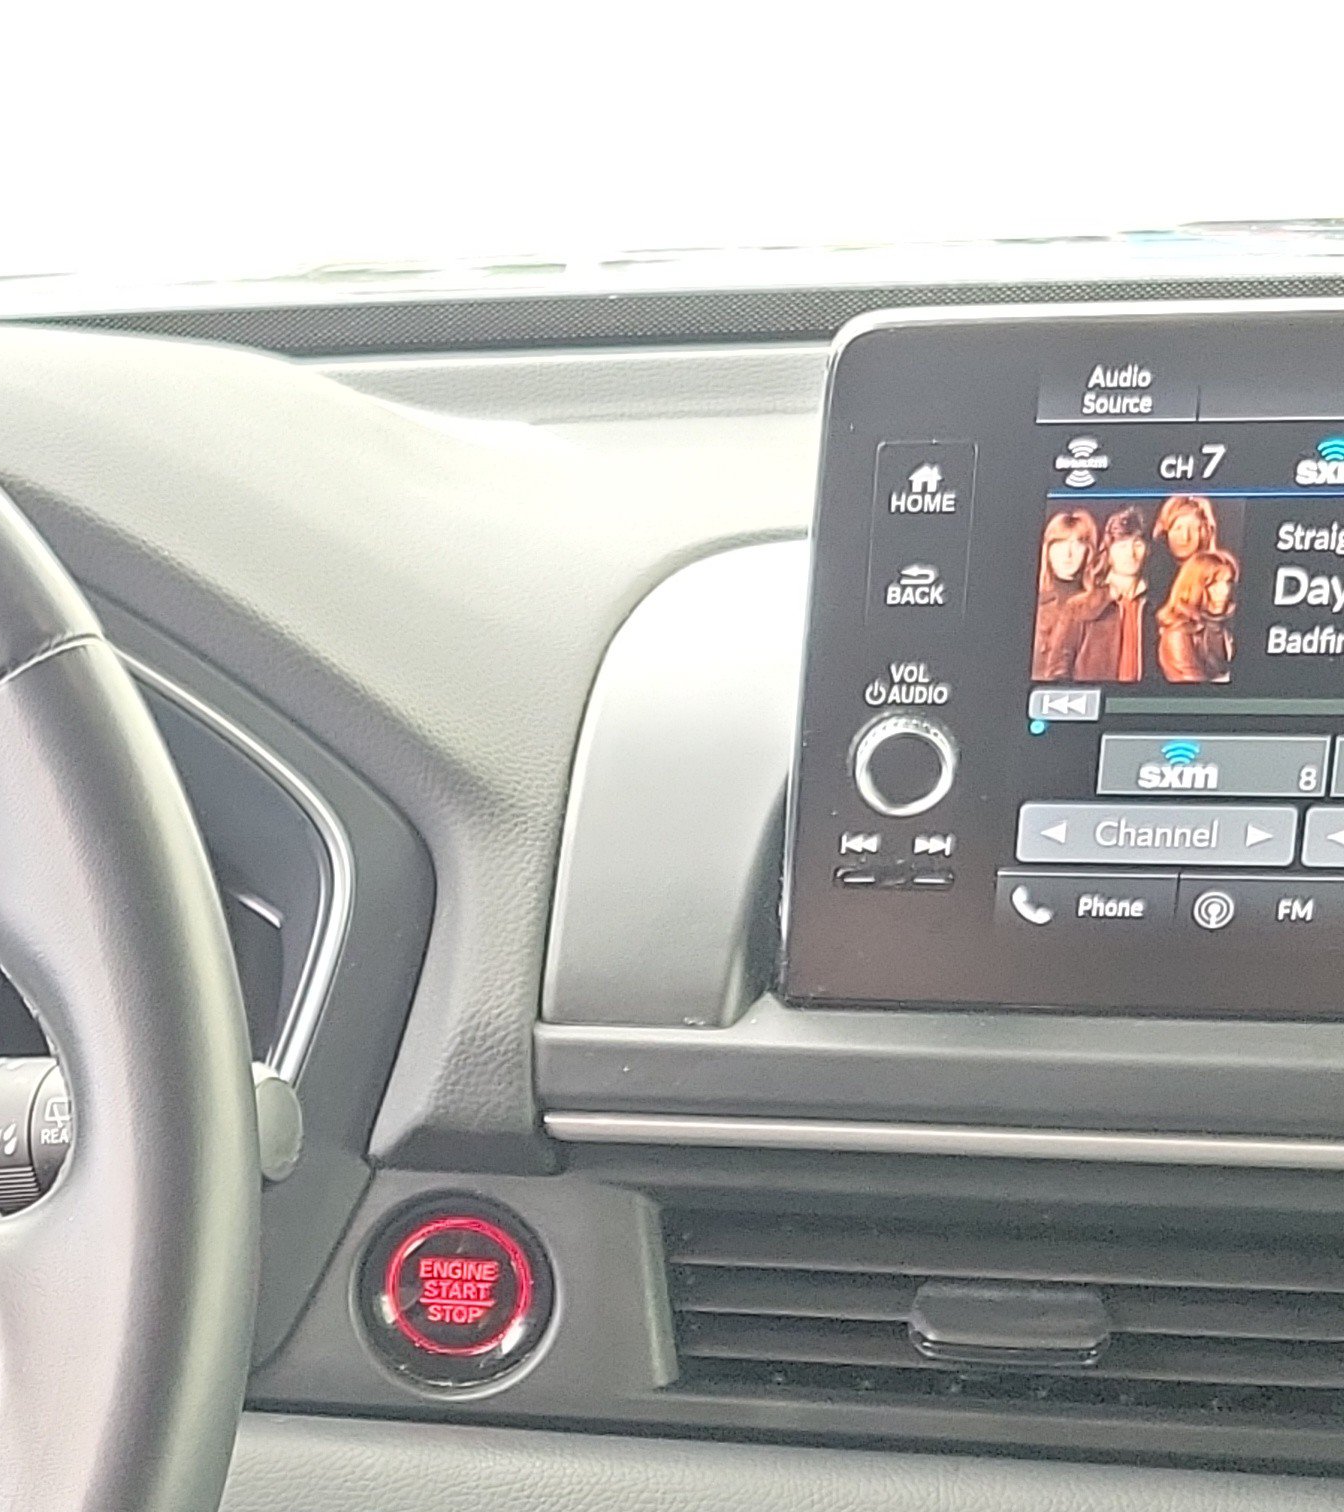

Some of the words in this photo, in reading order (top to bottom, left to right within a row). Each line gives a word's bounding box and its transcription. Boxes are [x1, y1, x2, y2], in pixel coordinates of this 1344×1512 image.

[1087, 363, 1152, 389] Audio
[1081, 392, 1153, 415] Source
[1159, 455, 1194, 480] CH
[1201, 443, 1227, 480] 7
[890, 492, 957, 514] HOME
[886, 584, 945, 606] BACK
[889, 664, 931, 683] VOL
[886, 684, 949, 705] AUDIO
[1138, 764, 1219, 790] sxm
[1298, 766, 1318, 792] 8
[1094, 820, 1219, 849] Channel
[1076, 895, 1145, 919] Phone
[1276, 898, 1314, 921] FM
[419, 1257, 499, 1281] ENGINE
[424, 1280, 493, 1300] START
[427, 1304, 485, 1323] STOP
